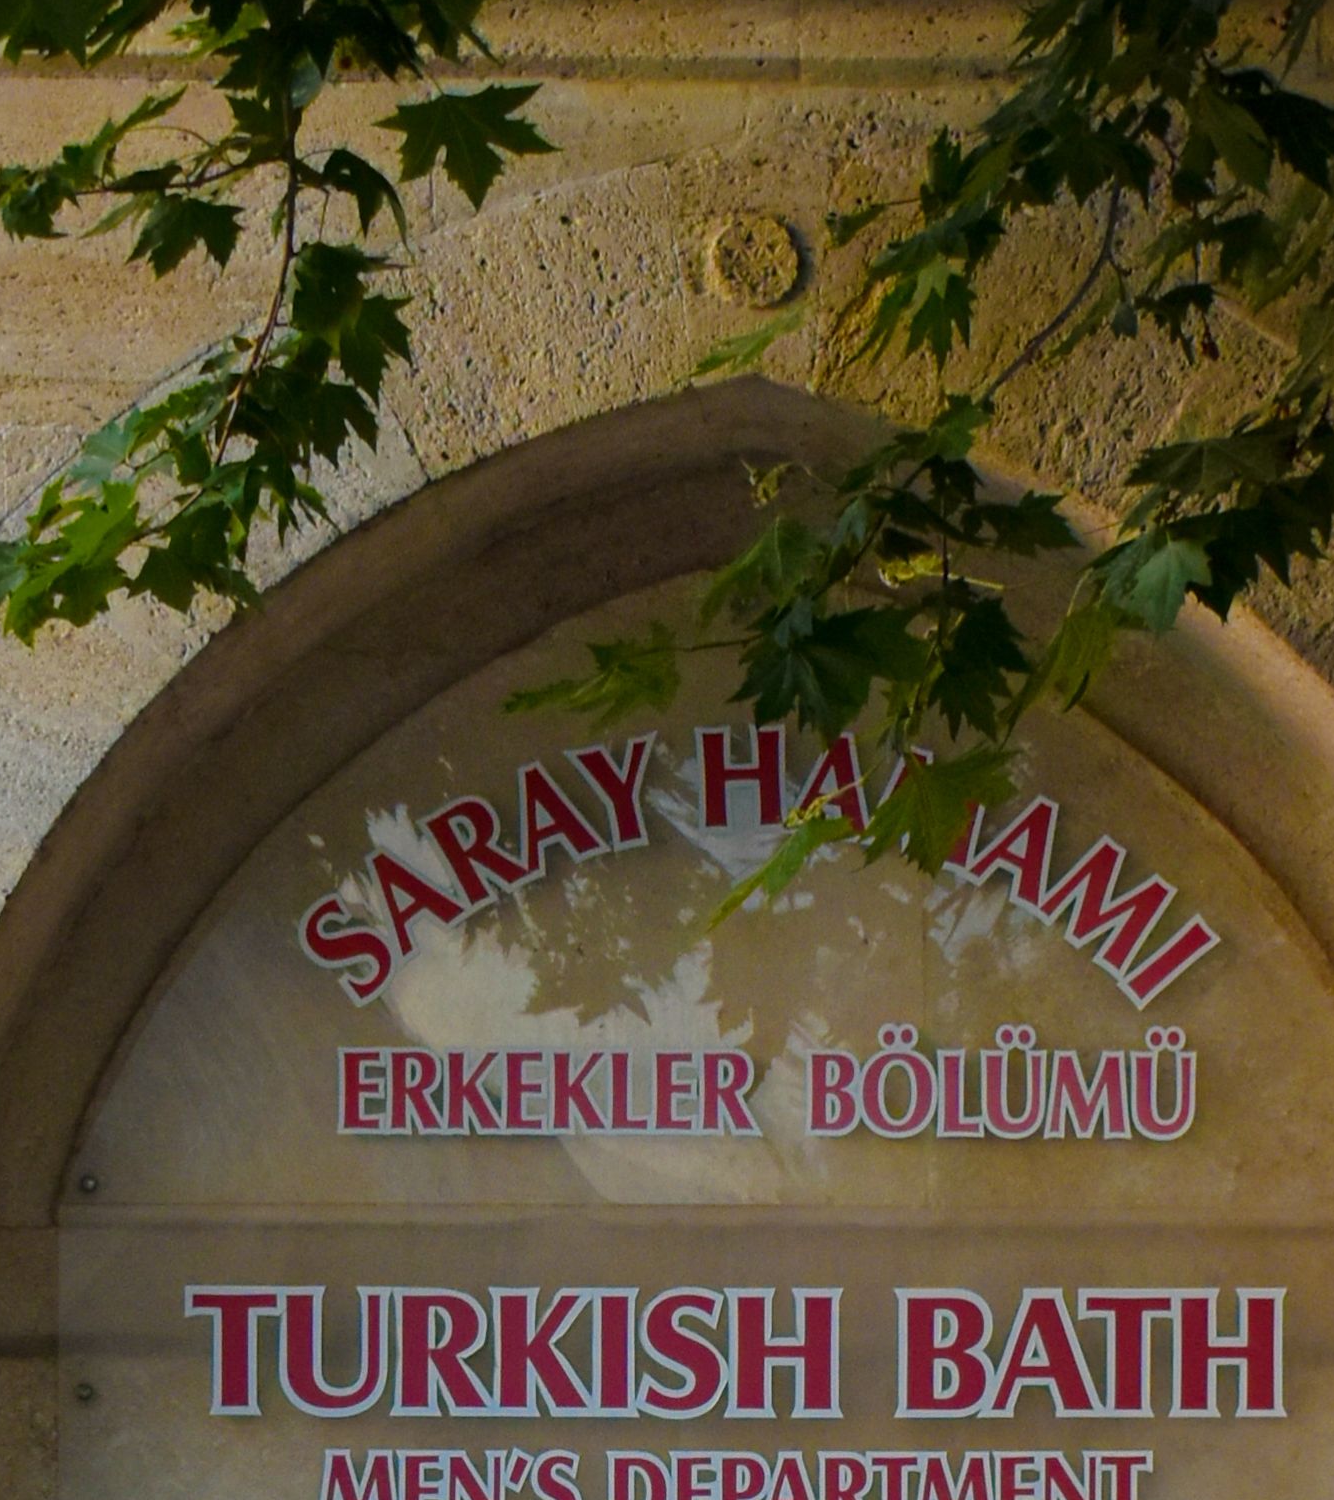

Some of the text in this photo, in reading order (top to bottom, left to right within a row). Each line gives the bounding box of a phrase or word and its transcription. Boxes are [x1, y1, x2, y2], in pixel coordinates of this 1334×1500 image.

[300, 733, 655, 1006] SARAY
[337, 1025, 1198, 1141] ERKEKLER BÖLÜMÜ
[186, 1287, 1285, 1418] TURKISH BATH
